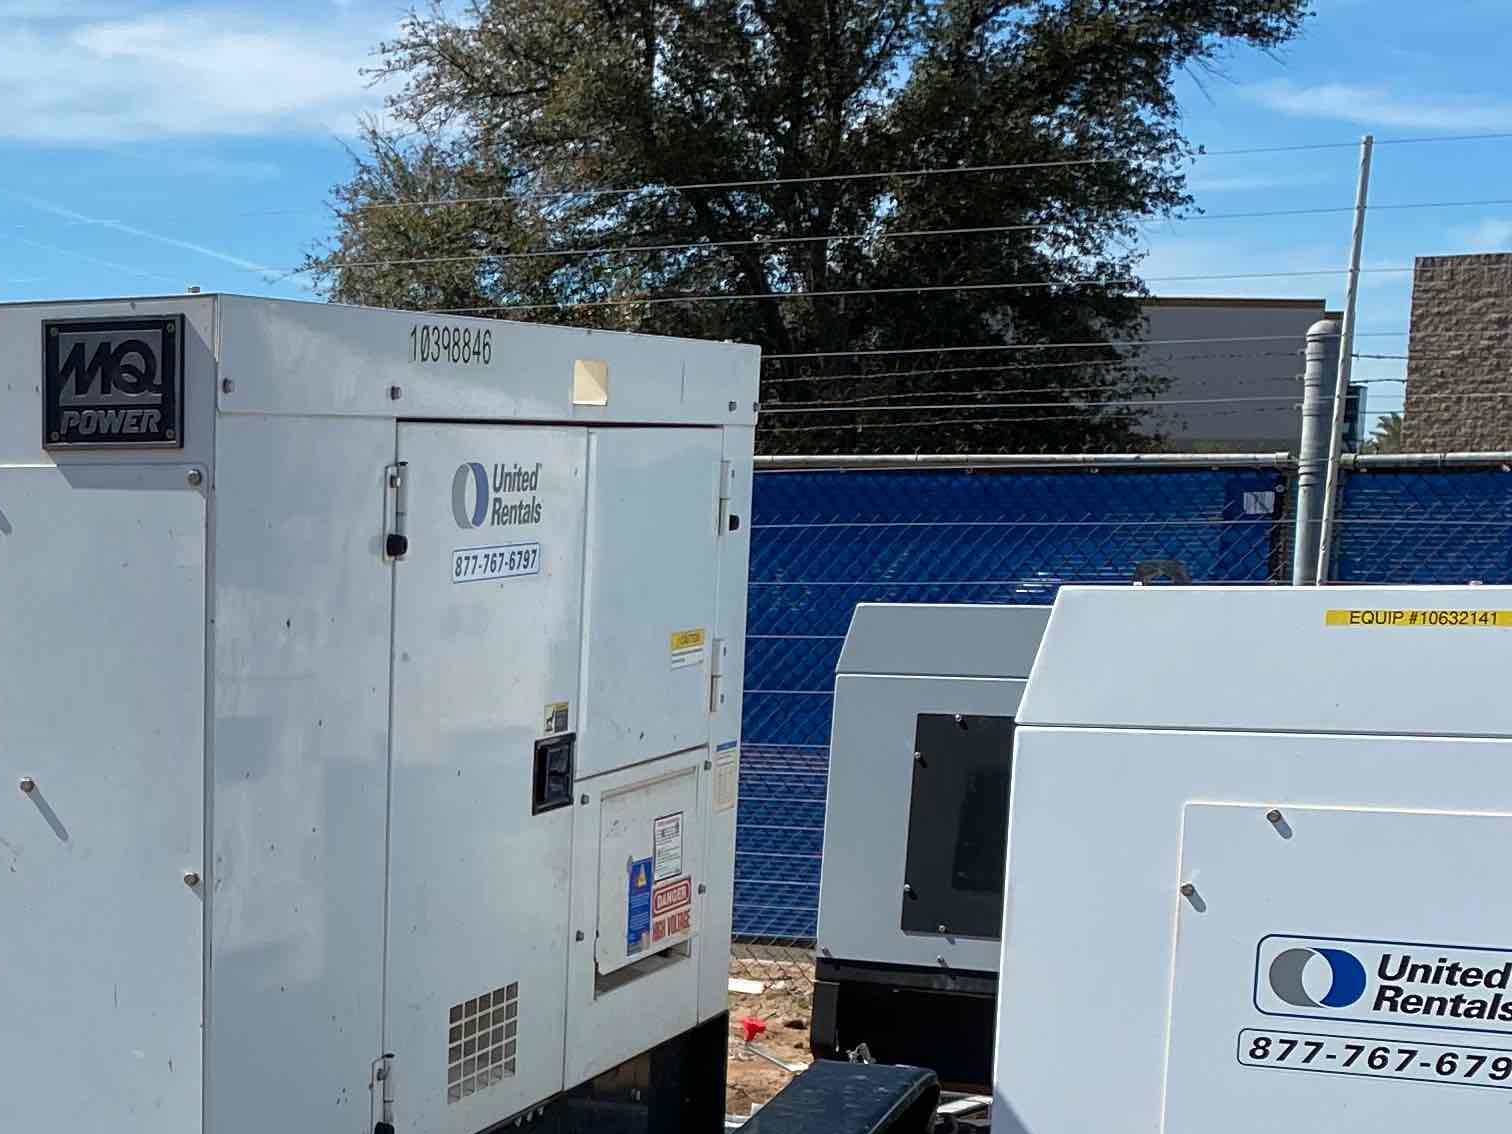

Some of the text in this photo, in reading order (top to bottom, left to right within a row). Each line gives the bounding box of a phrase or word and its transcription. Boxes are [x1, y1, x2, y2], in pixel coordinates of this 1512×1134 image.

[409, 324, 492, 364] 10398846
[56, 339, 161, 395] MQ
[60, 409, 161, 435] POWER
[492, 463, 541, 493] United
[490, 497, 542, 527] Rentals
[454, 549, 538, 577] 877-767-6797
[1349, 610, 1499, 626] EQUIP #10632141
[1377, 954, 1512, 989] United
[1372, 985, 1512, 1022] Rentals
